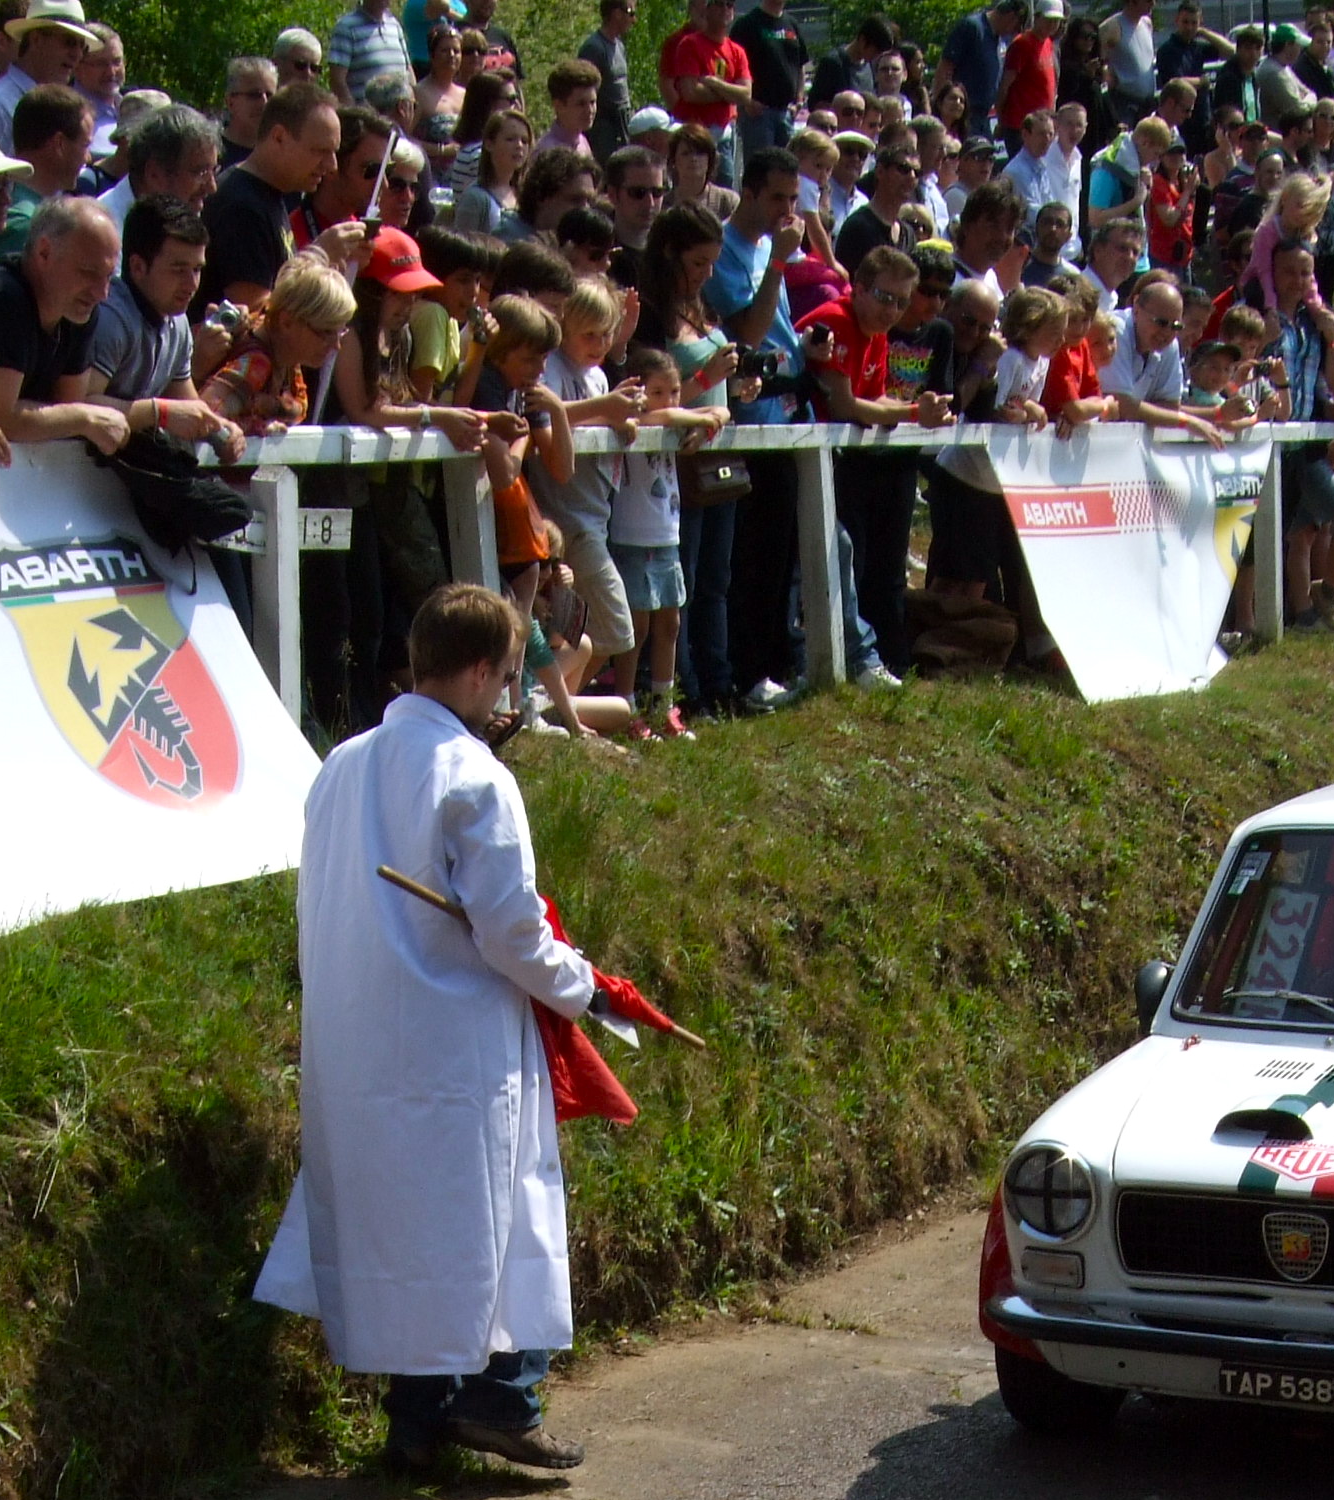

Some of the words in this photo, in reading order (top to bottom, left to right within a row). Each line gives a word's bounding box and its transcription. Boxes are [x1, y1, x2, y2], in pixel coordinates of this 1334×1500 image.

[1022, 501, 1087, 526] ABARTH
[0, 549, 148, 592] ABARTH
[1221, 1369, 1273, 1396] TAP
